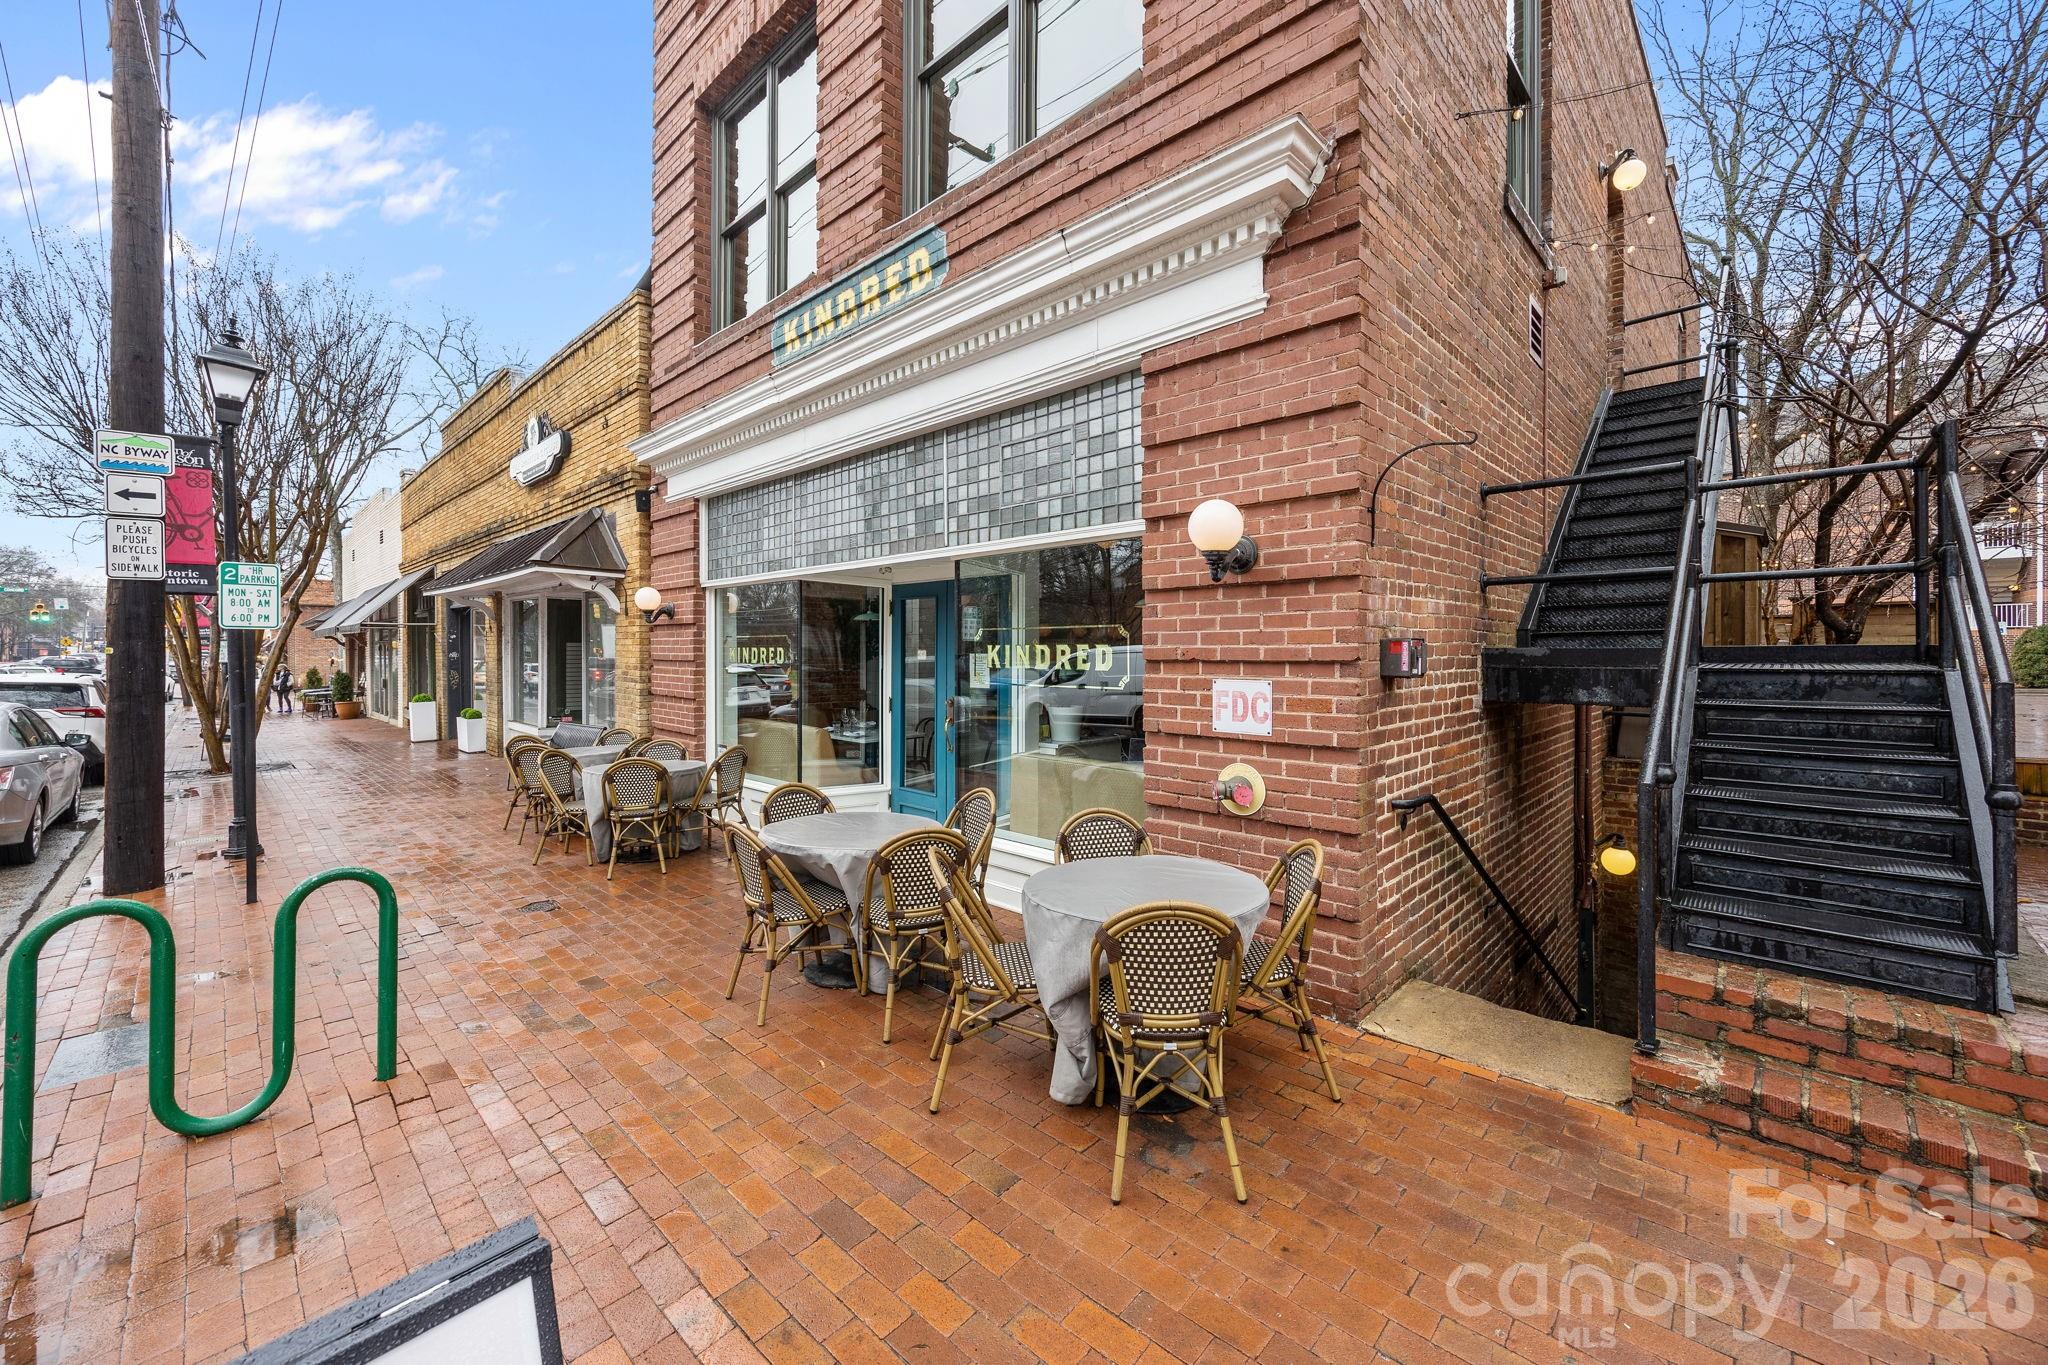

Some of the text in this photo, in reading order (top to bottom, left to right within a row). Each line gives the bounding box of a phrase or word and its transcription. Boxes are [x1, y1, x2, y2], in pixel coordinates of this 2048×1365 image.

[783, 246, 933, 357] KINDRED
[101, 444, 119, 455] NC
[125, 446, 169, 459] BYWAY
[116, 525, 153, 535] PLEASE
[122, 535, 147, 544] PUSH
[112, 545, 158, 555] BICYCLES
[111, 562, 160, 572] SIDEWALK
[252, 566, 264, 575] HR
[224, 567, 237, 580] 2
[240, 574, 276, 585] PARKING
[227, 588, 246, 597] MON
[256, 589, 272, 598] SAT
[230, 598, 270, 608] 8:00 AM
[230, 613, 270, 622] 6:00 PM
[728, 647, 785, 665] KINDRED
[986, 643, 1114, 672] KINDRED
[1215, 689, 1270, 725] FDC
